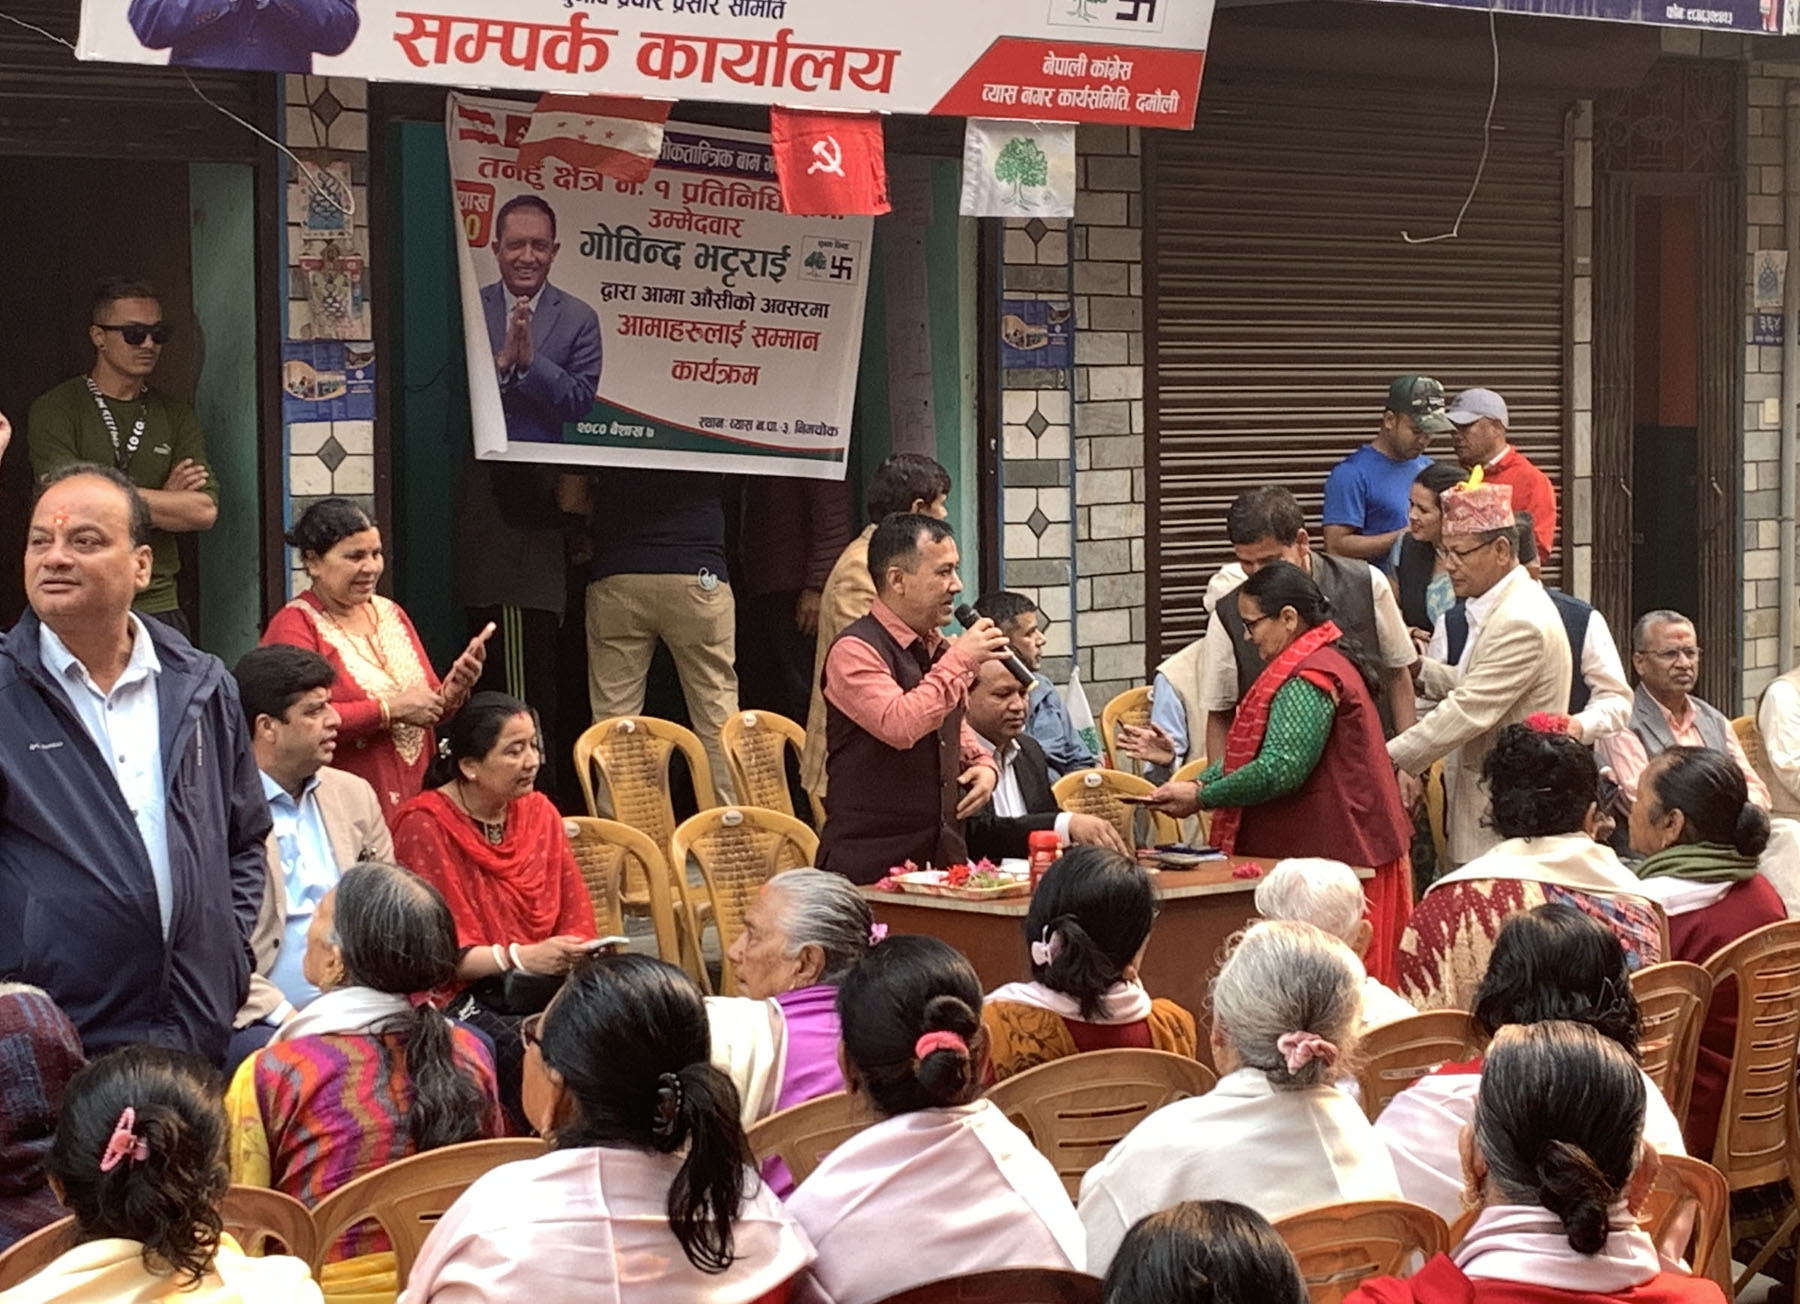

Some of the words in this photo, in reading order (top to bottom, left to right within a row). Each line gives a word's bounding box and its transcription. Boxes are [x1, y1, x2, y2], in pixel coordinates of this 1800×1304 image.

[394, 11, 619, 74] सम्पर्क
[636, 28, 902, 93] कार्यालय
[1042, 50, 1088, 78] नेपाली
[1090, 55, 1134, 81] कांग्रेस
[982, 83, 1019, 104] व्यास
[1020, 86, 1056, 107] नगर
[1136, 88, 1180, 114] दमौली
[654, 180, 671, 200] १
[648, 207, 744, 238] उम्मेदवार
[579, 222, 686, 270] गोविन्द
[600, 282, 637, 302] द्वारा
[641, 286, 684, 306] आमा
[760, 297, 831, 319] अवसरमा
[751, 326, 821, 352] सम्मान
[671, 357, 761, 386] कार्यक्रम
